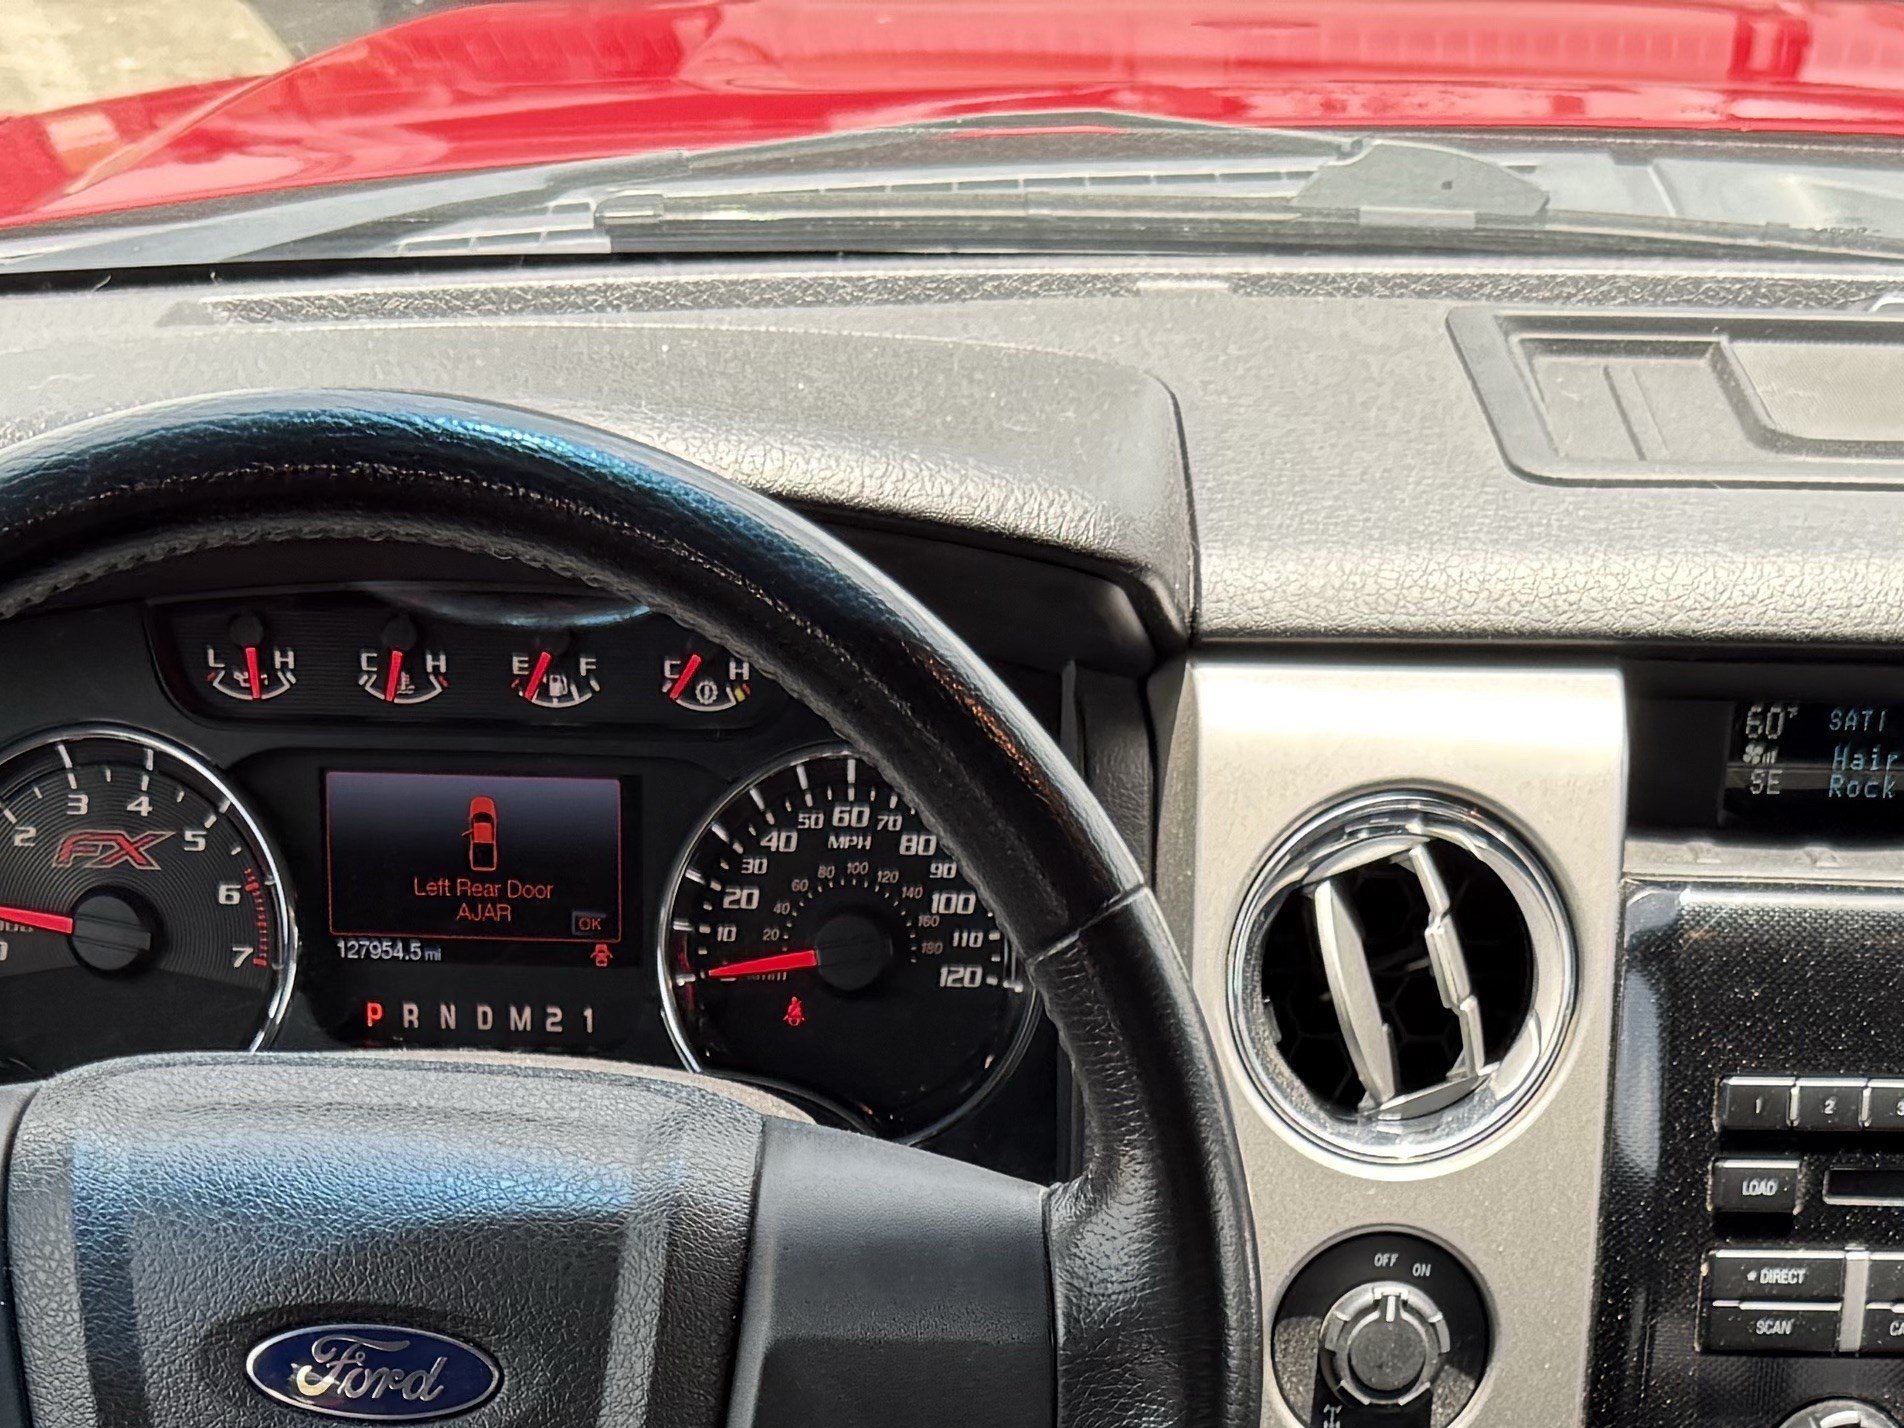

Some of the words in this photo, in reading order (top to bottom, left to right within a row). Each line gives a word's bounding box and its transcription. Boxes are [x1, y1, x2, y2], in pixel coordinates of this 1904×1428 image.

[208, 648, 225, 667] L
[275, 649, 294, 669] H
[360, 653, 377, 671] C
[426, 654, 446, 673] H
[513, 656, 529, 675] E
[580, 658, 596, 676] F
[663, 660, 681, 678] C
[730, 661, 749, 680] H
[1832, 745, 1900, 771] Hair
[1828, 775, 1896, 799] Rock
[67, 794, 89, 815] 3
[127, 796, 152, 817] 4
[797, 813, 824, 829] 50
[832, 807, 870, 827] 60
[877, 815, 902, 831] 70
[14, 826, 37, 847] 2
[184, 830, 207, 851] 5
[761, 832, 797, 852] 40
[828, 834, 872, 850] MPH
[899, 835, 936, 856] 80
[52, 829, 177, 870] FX
[741, 859, 767, 875] 30
[818, 866, 835, 879] 80
[847, 862, 869, 875] 100
[930, 862, 957, 879] 90
[791, 879, 808, 892] 60
[877, 870, 899, 883] 120
[219, 884, 241, 905] 6
[414, 877, 450, 897] Left
[457, 878, 501, 898] Rear
[508, 880, 553, 899] Door
[902, 886, 923, 900] 140
[723, 887, 759, 909] 20
[931, 893, 976, 915] 100
[456, 903, 511, 922] AJAR
[773, 902, 790, 915] 40
[579, 916, 602, 930] OK
[918, 915, 940, 927] 160
[716, 926, 736, 942] 10
[762, 929, 779, 941] 20
[953, 931, 983, 948] 110
[232, 946, 253, 968] 7
[337, 940, 421, 961] 127954.5
[425, 946, 441, 961] mi
[921, 942, 943, 955] 180
[940, 967, 982, 988] 120
[367, 1002, 383, 1027] P
[403, 1003, 419, 1028] R
[440, 1004, 456, 1029] N
[477, 1005, 493, 1030] D
[510, 1006, 531, 1031] M
[546, 1007, 562, 1032] 2
[584, 1007, 593, 1033] 1
[1755, 1098, 1763, 1114] 1
[1825, 1098, 1837, 1114] 2
[1742, 1177, 1778, 1196] LOAD
[1374, 1253, 1398, 1267] OFF
[1412, 1263, 1431, 1277] ON
[1760, 1267, 1807, 1285] DIRECT
[1756, 1318, 1794, 1335] SCAN
[291, 1333, 447, 1402] Ford
